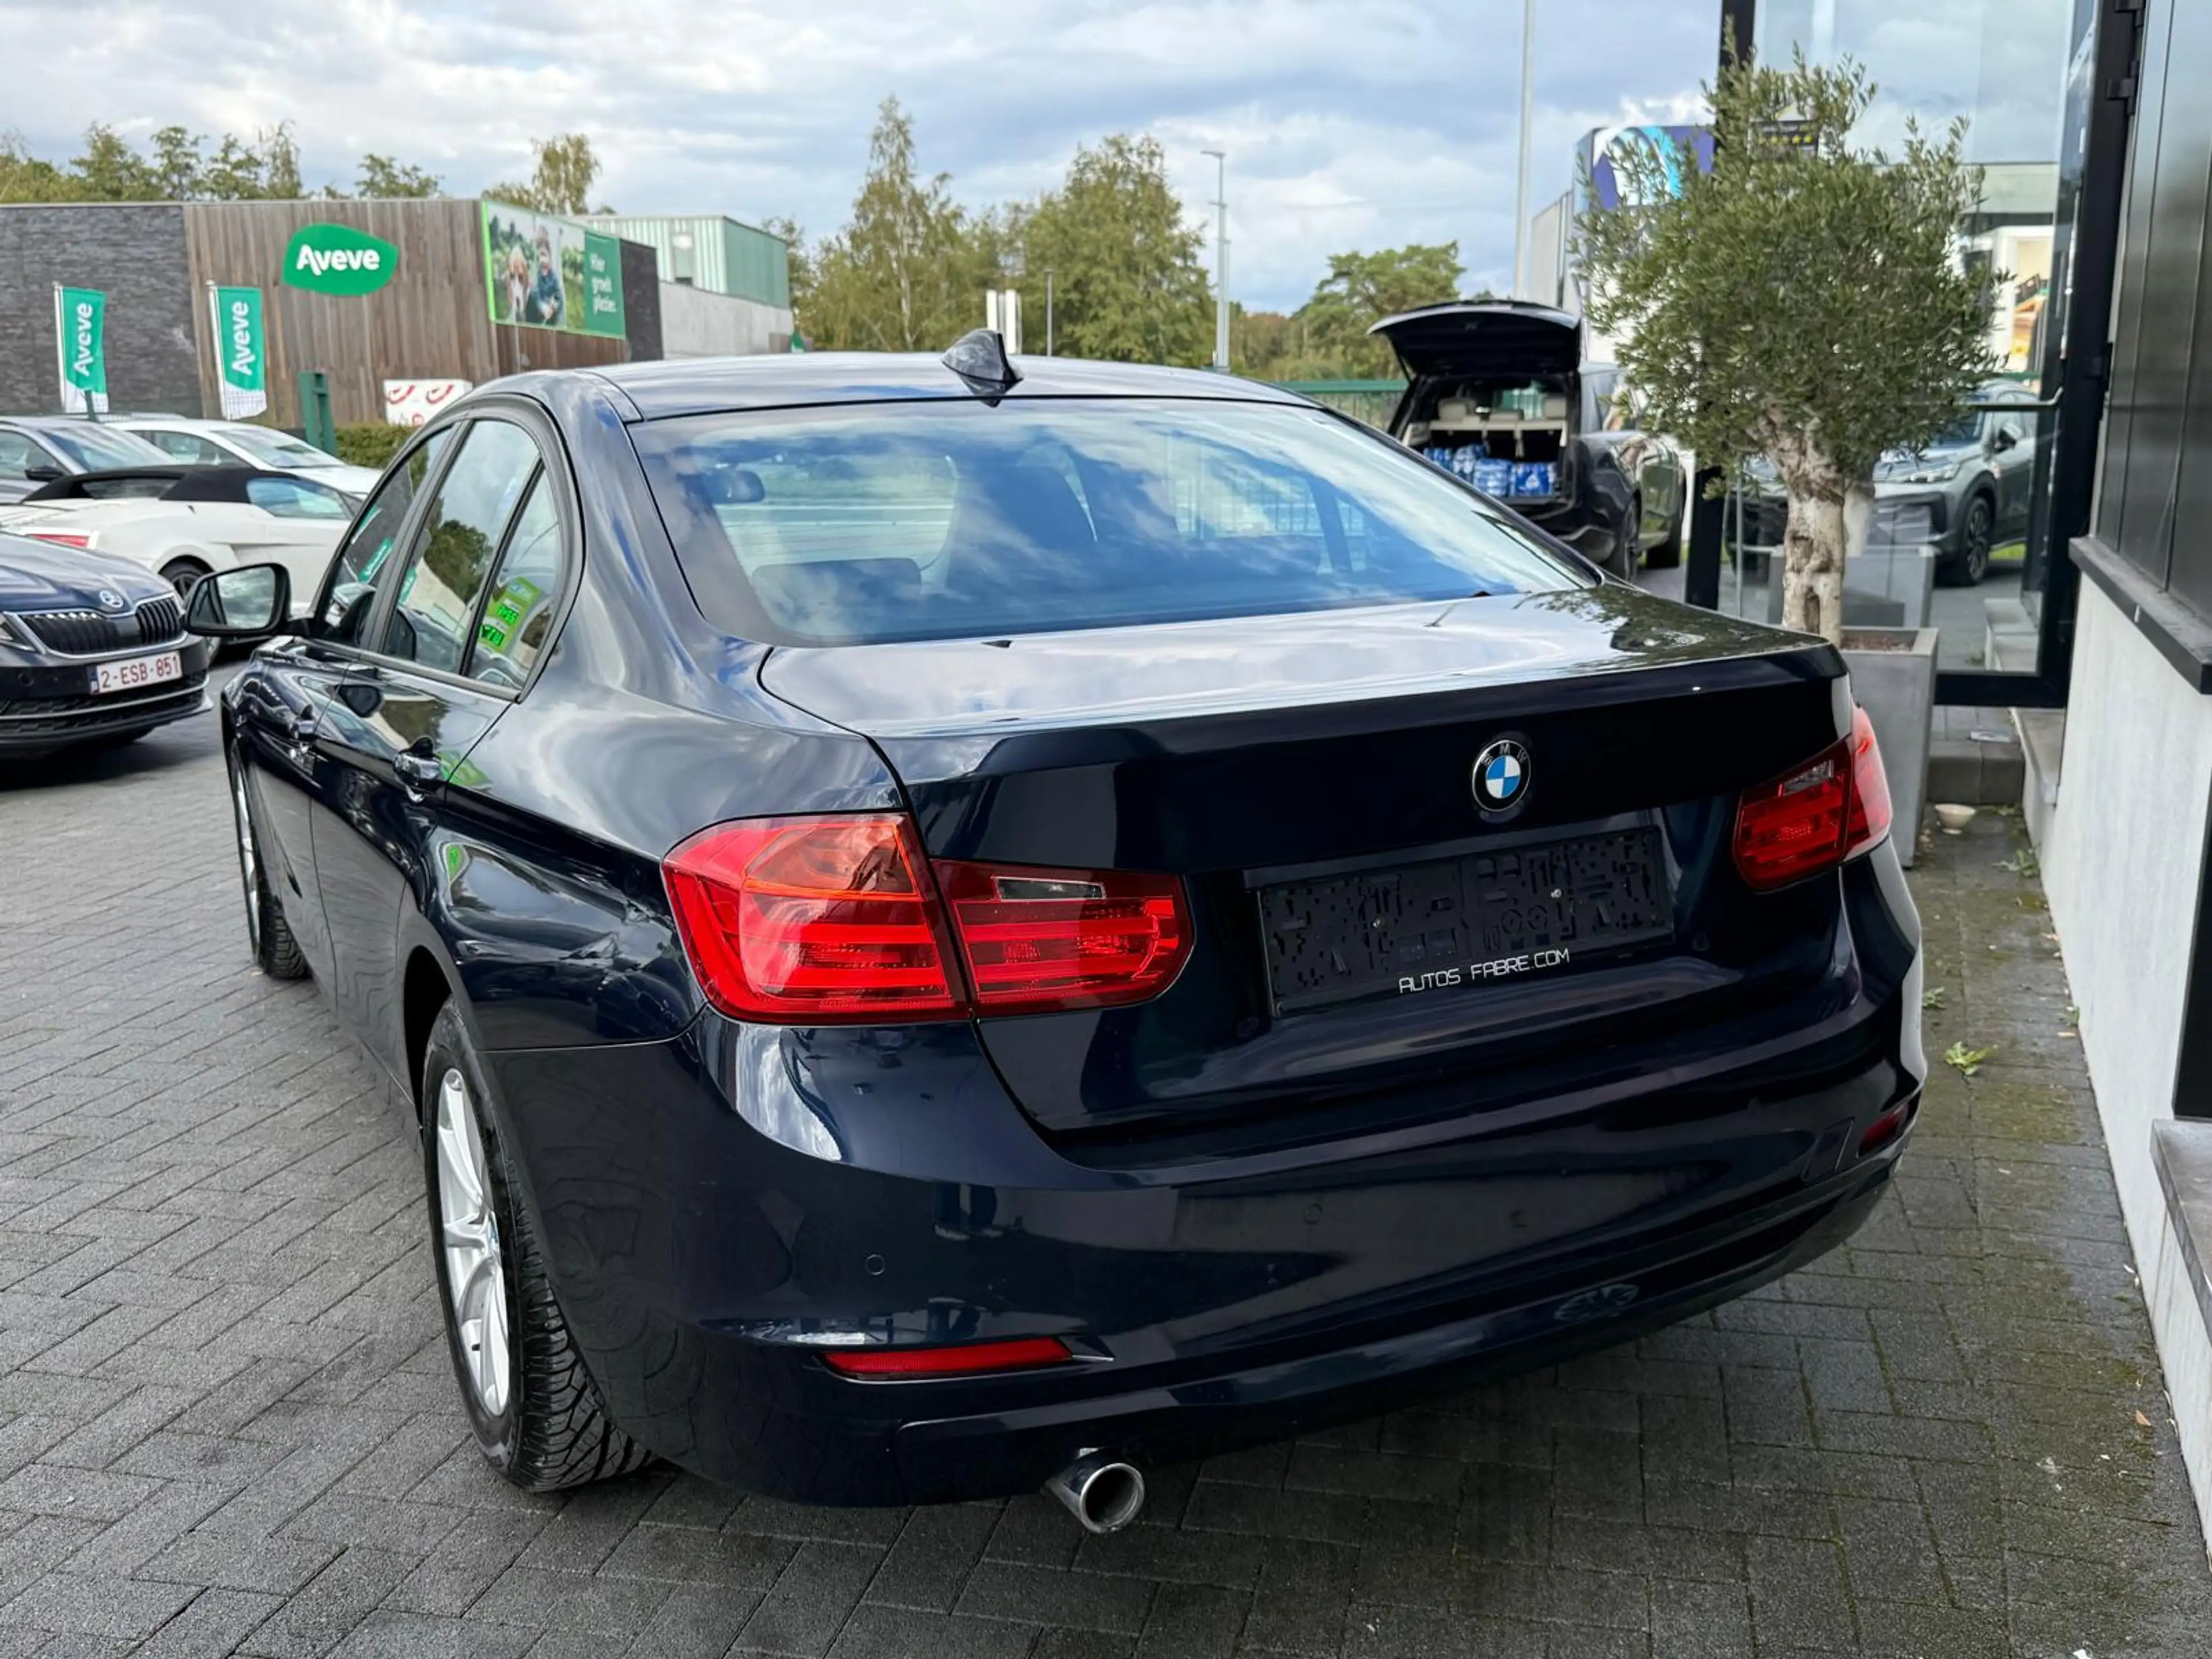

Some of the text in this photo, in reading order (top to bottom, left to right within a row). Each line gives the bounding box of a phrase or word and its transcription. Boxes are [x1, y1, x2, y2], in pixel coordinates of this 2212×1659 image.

[296, 244, 380, 275] Aveve
[73, 302, 93, 376] Aveve
[232, 301, 251, 376] Aveve
[1480, 743, 1527, 766] BMW
[1399, 948, 1570, 994] AUTOS FABRE.COM
